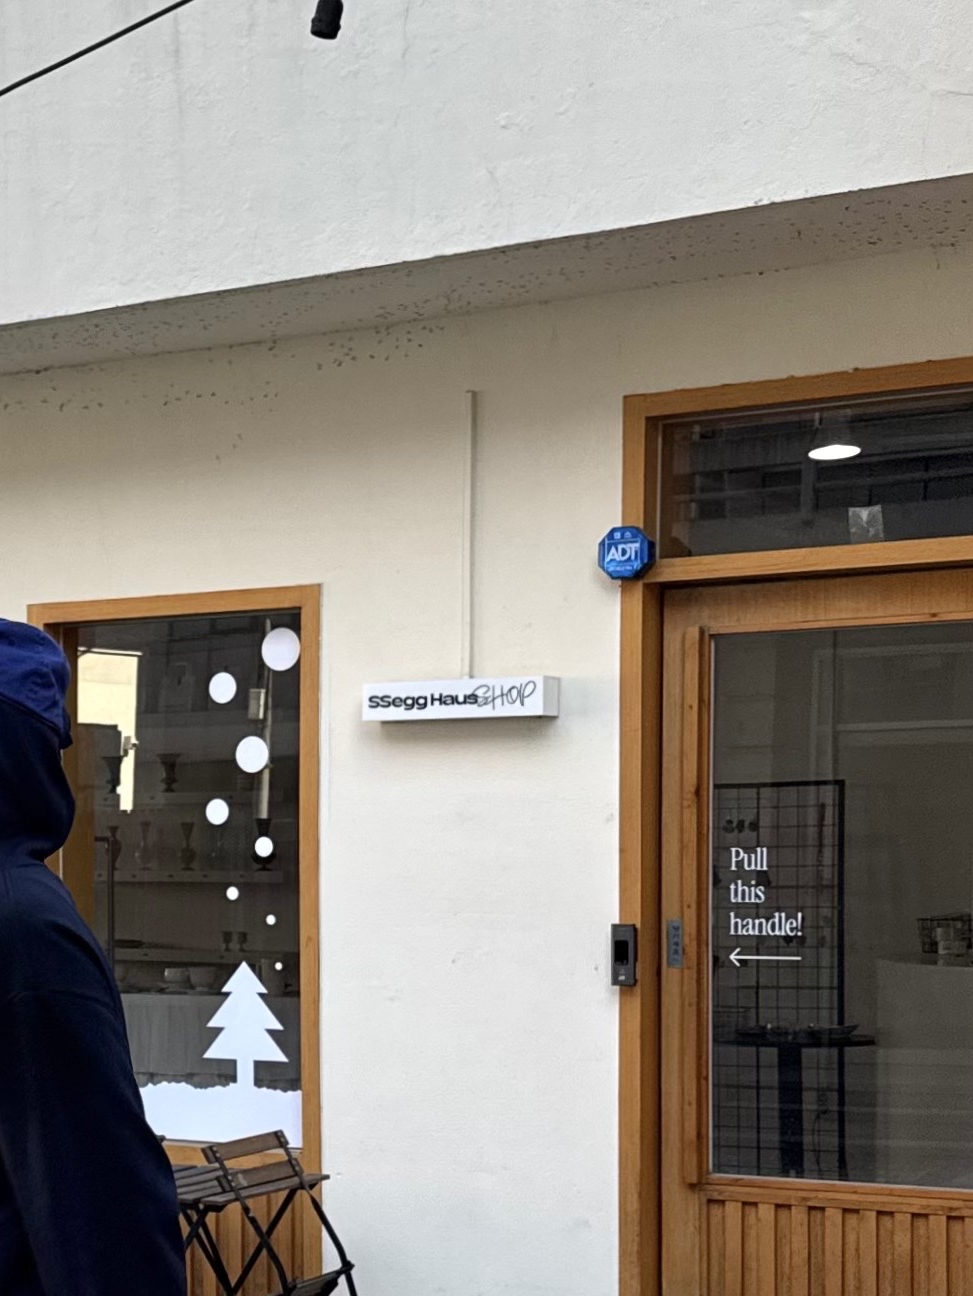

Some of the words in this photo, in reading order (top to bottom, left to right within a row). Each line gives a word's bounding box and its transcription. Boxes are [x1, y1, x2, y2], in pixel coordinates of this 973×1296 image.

[606, 543, 640, 561] ADT
[368, 694, 428, 711] SSegg
[430, 692, 479, 707] Haus
[472, 680, 537, 711] SHOP
[729, 847, 769, 871] Pull
[729, 879, 766, 903] this
[729, 911, 803, 937] handle!
